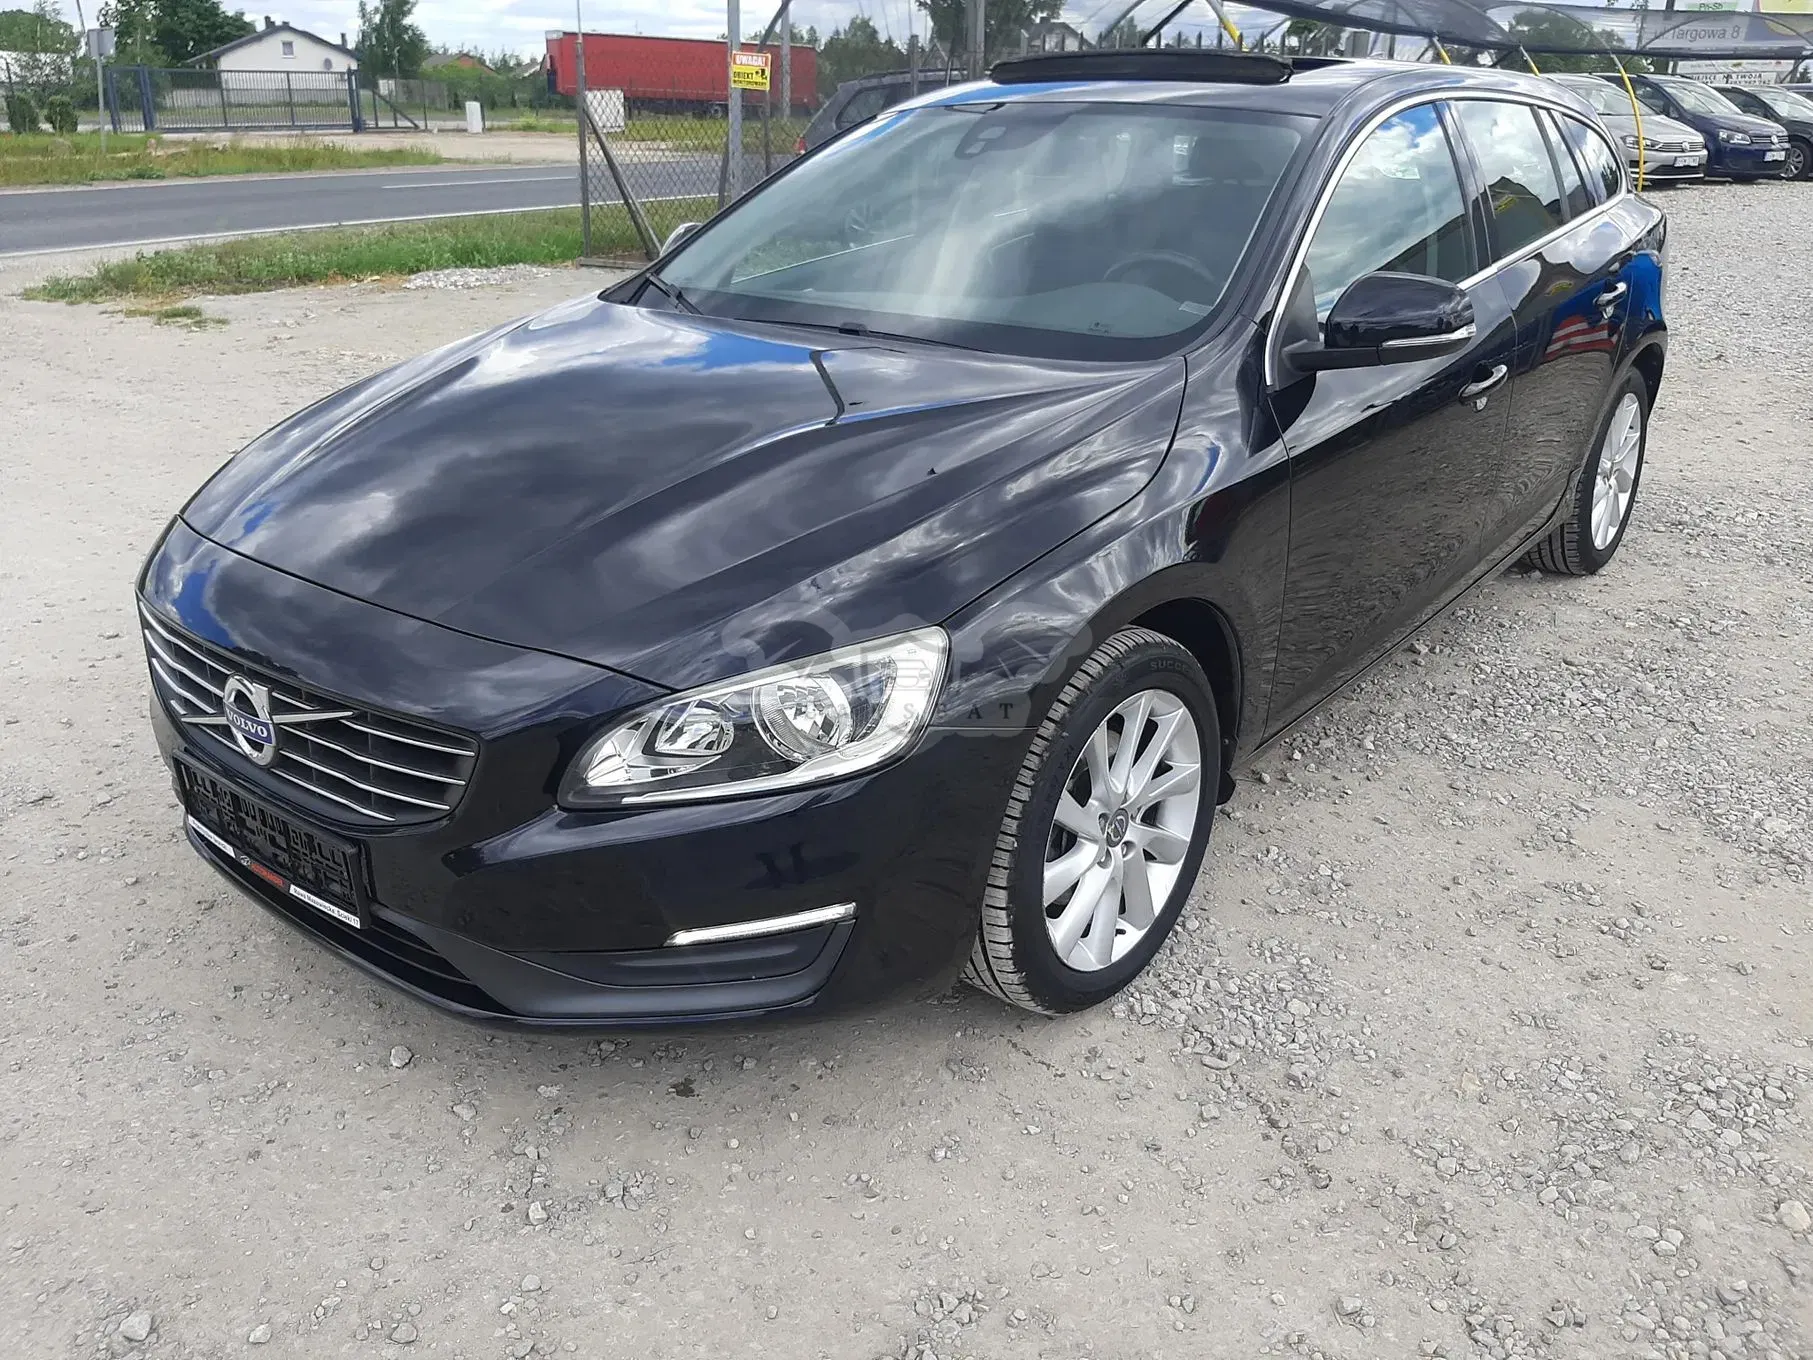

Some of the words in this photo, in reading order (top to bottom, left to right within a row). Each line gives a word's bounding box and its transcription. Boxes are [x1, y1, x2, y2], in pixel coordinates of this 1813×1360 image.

[1671, 26, 1727, 42] Targowa
[1731, 25, 1741, 39] 8
[735, 54, 765, 66] UWAGA!
[733, 71, 754, 80] OBIEKT
[226, 706, 268, 738] VOLVO
